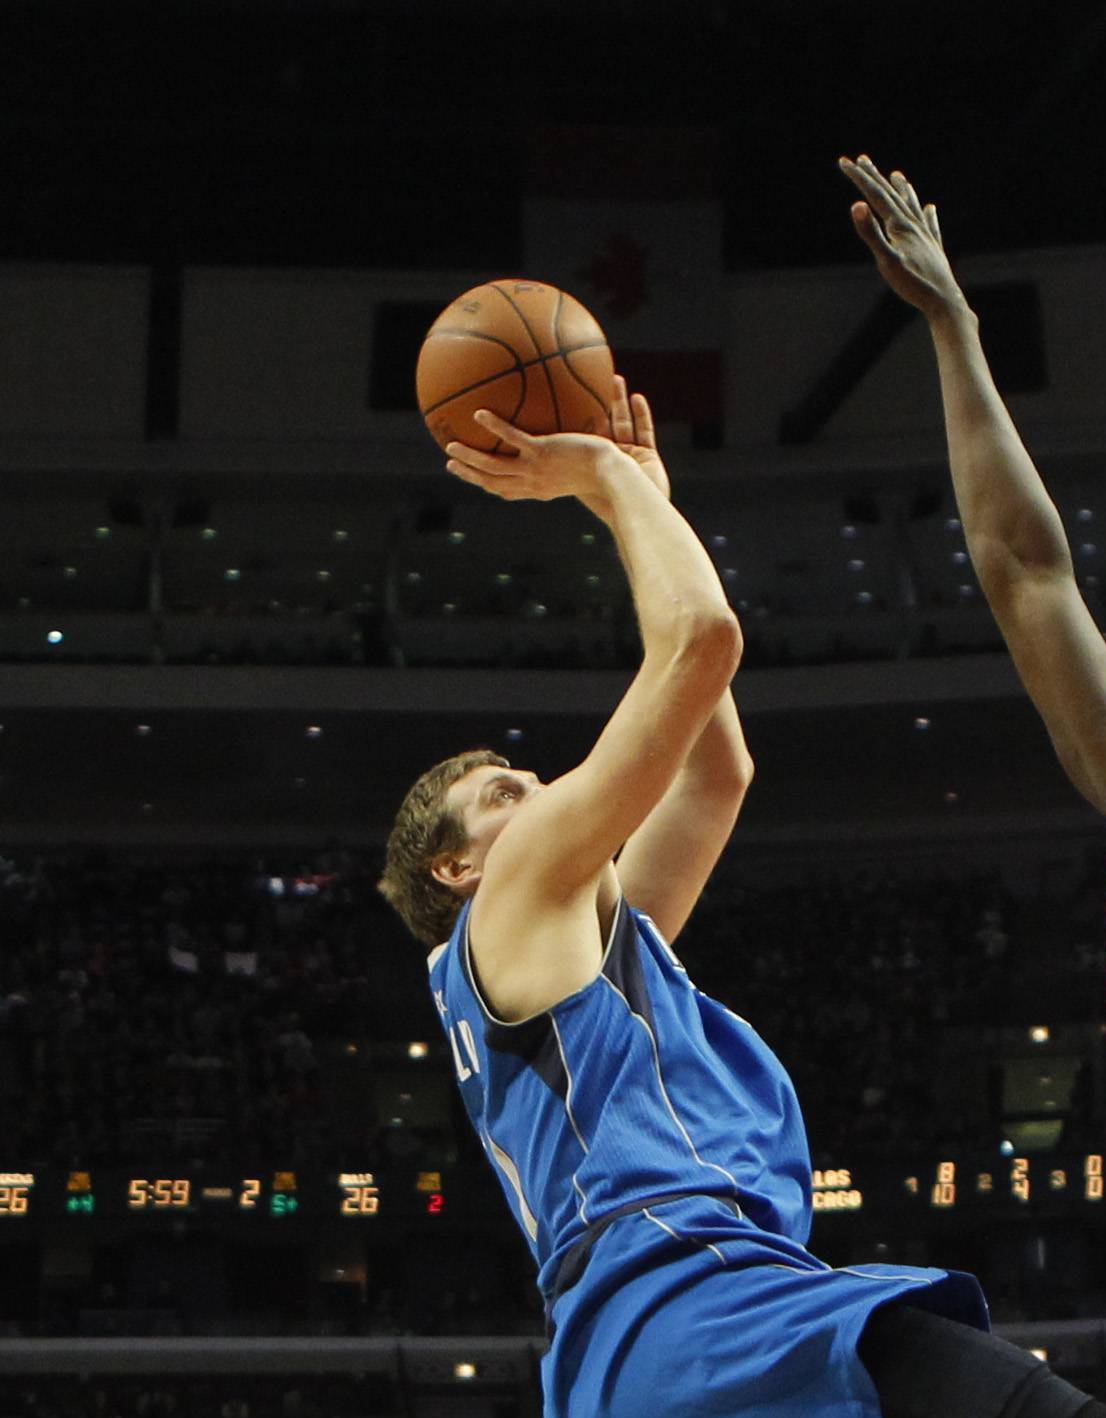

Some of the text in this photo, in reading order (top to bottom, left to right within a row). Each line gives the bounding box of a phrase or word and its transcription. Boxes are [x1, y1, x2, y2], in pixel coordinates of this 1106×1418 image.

[129, 1180, 190, 1205] 5:59
[240, 1180, 260, 1206] 2
[342, 1187, 379, 1213] 26
[427, 1194, 443, 1213] 2
